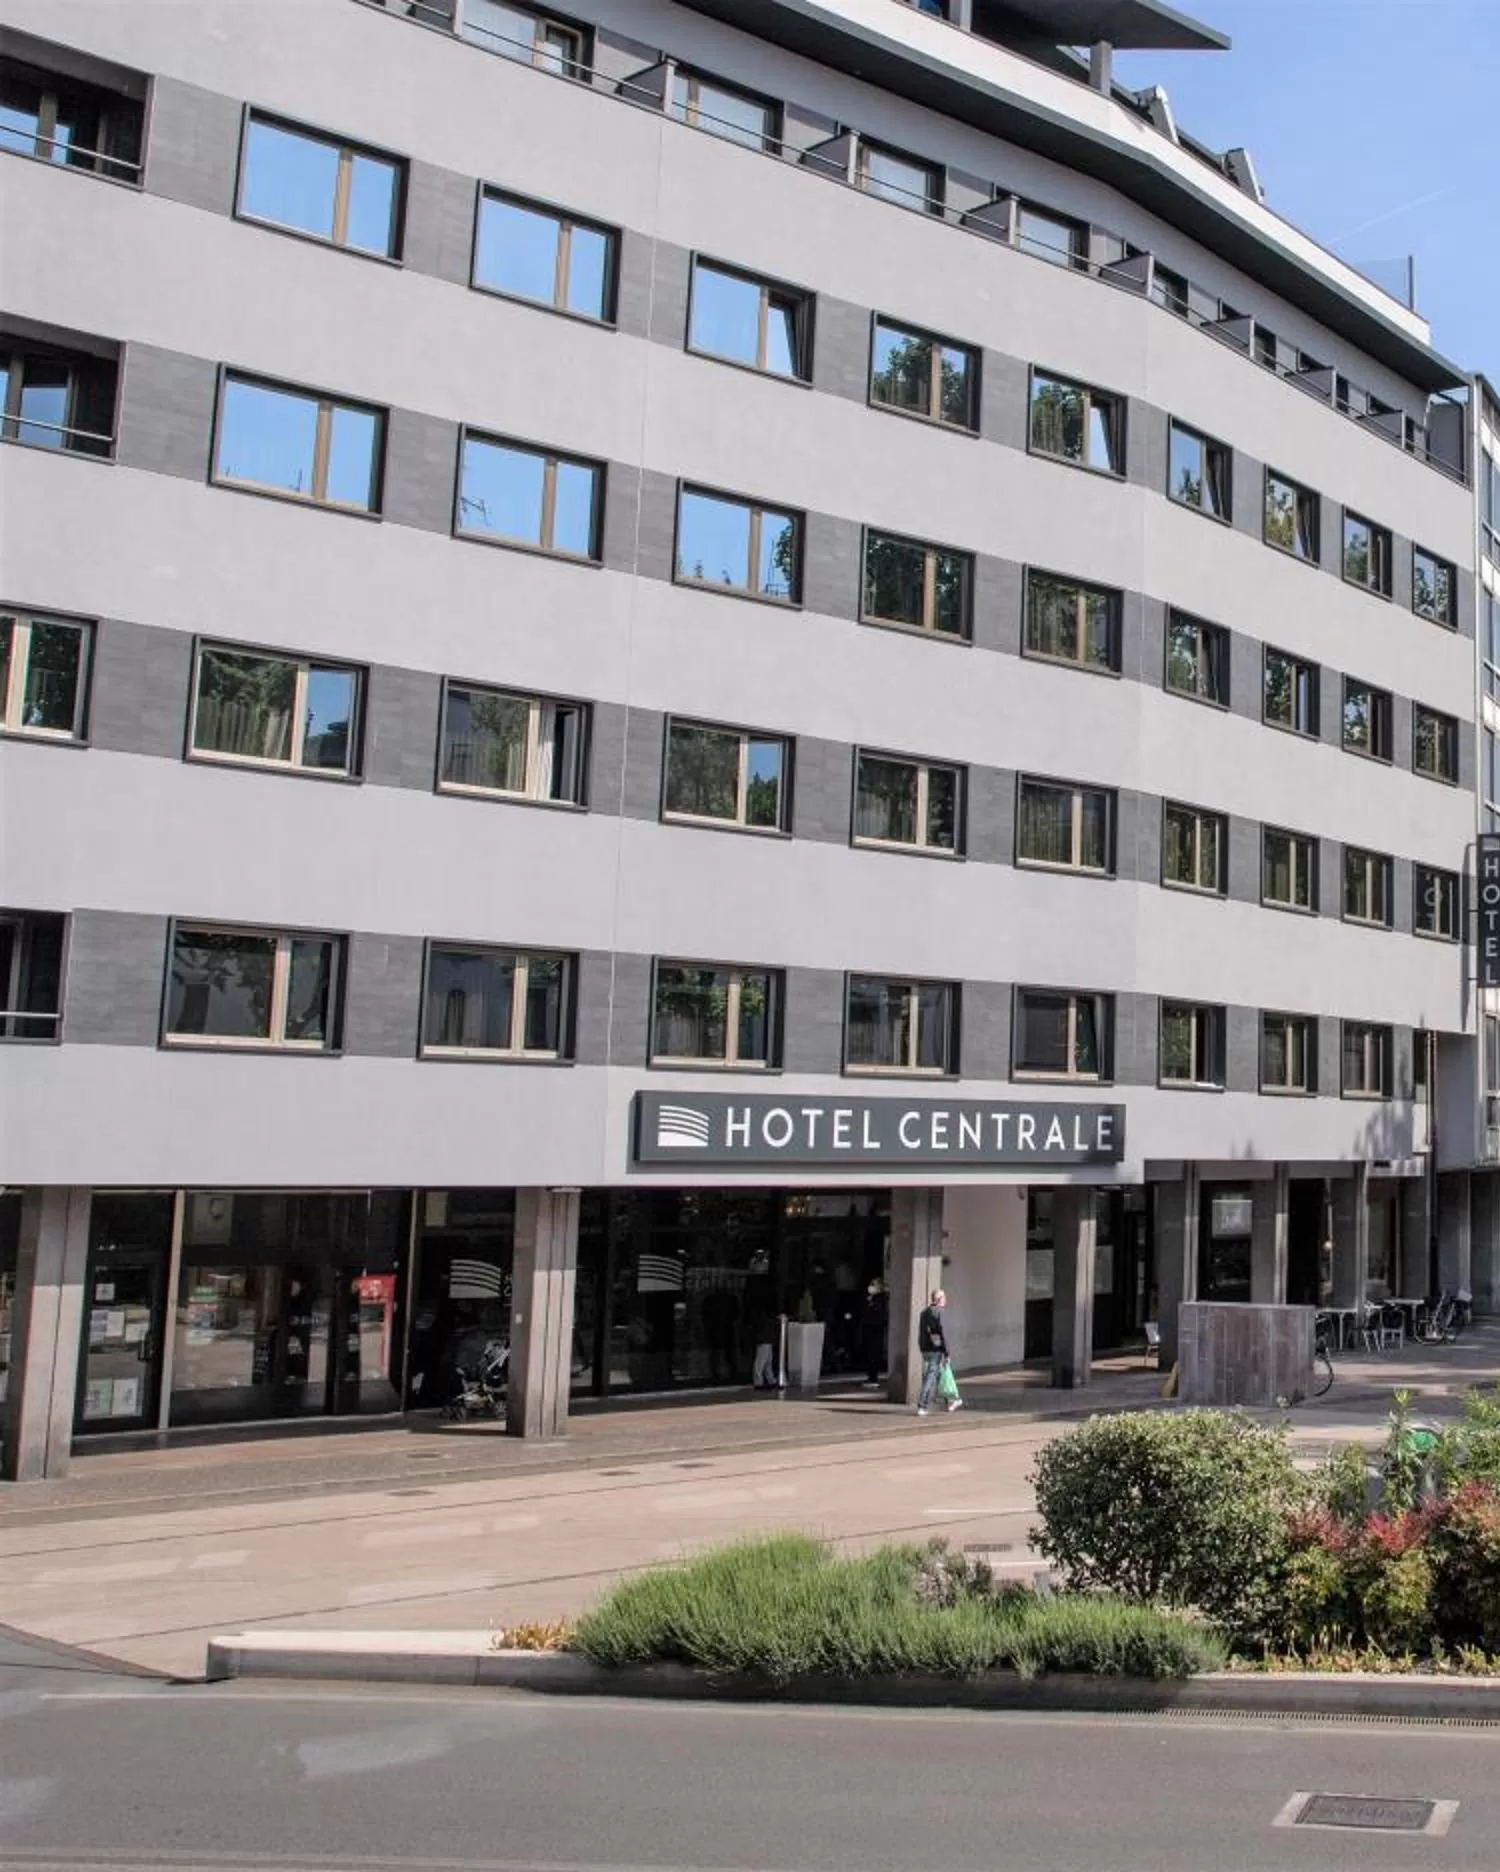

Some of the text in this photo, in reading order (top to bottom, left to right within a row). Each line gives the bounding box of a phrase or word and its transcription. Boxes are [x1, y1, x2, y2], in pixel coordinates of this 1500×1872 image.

[1482, 857, 1500, 984] HOTEL
[725, 1106, 1114, 1152] HOTEL CENTRALE
